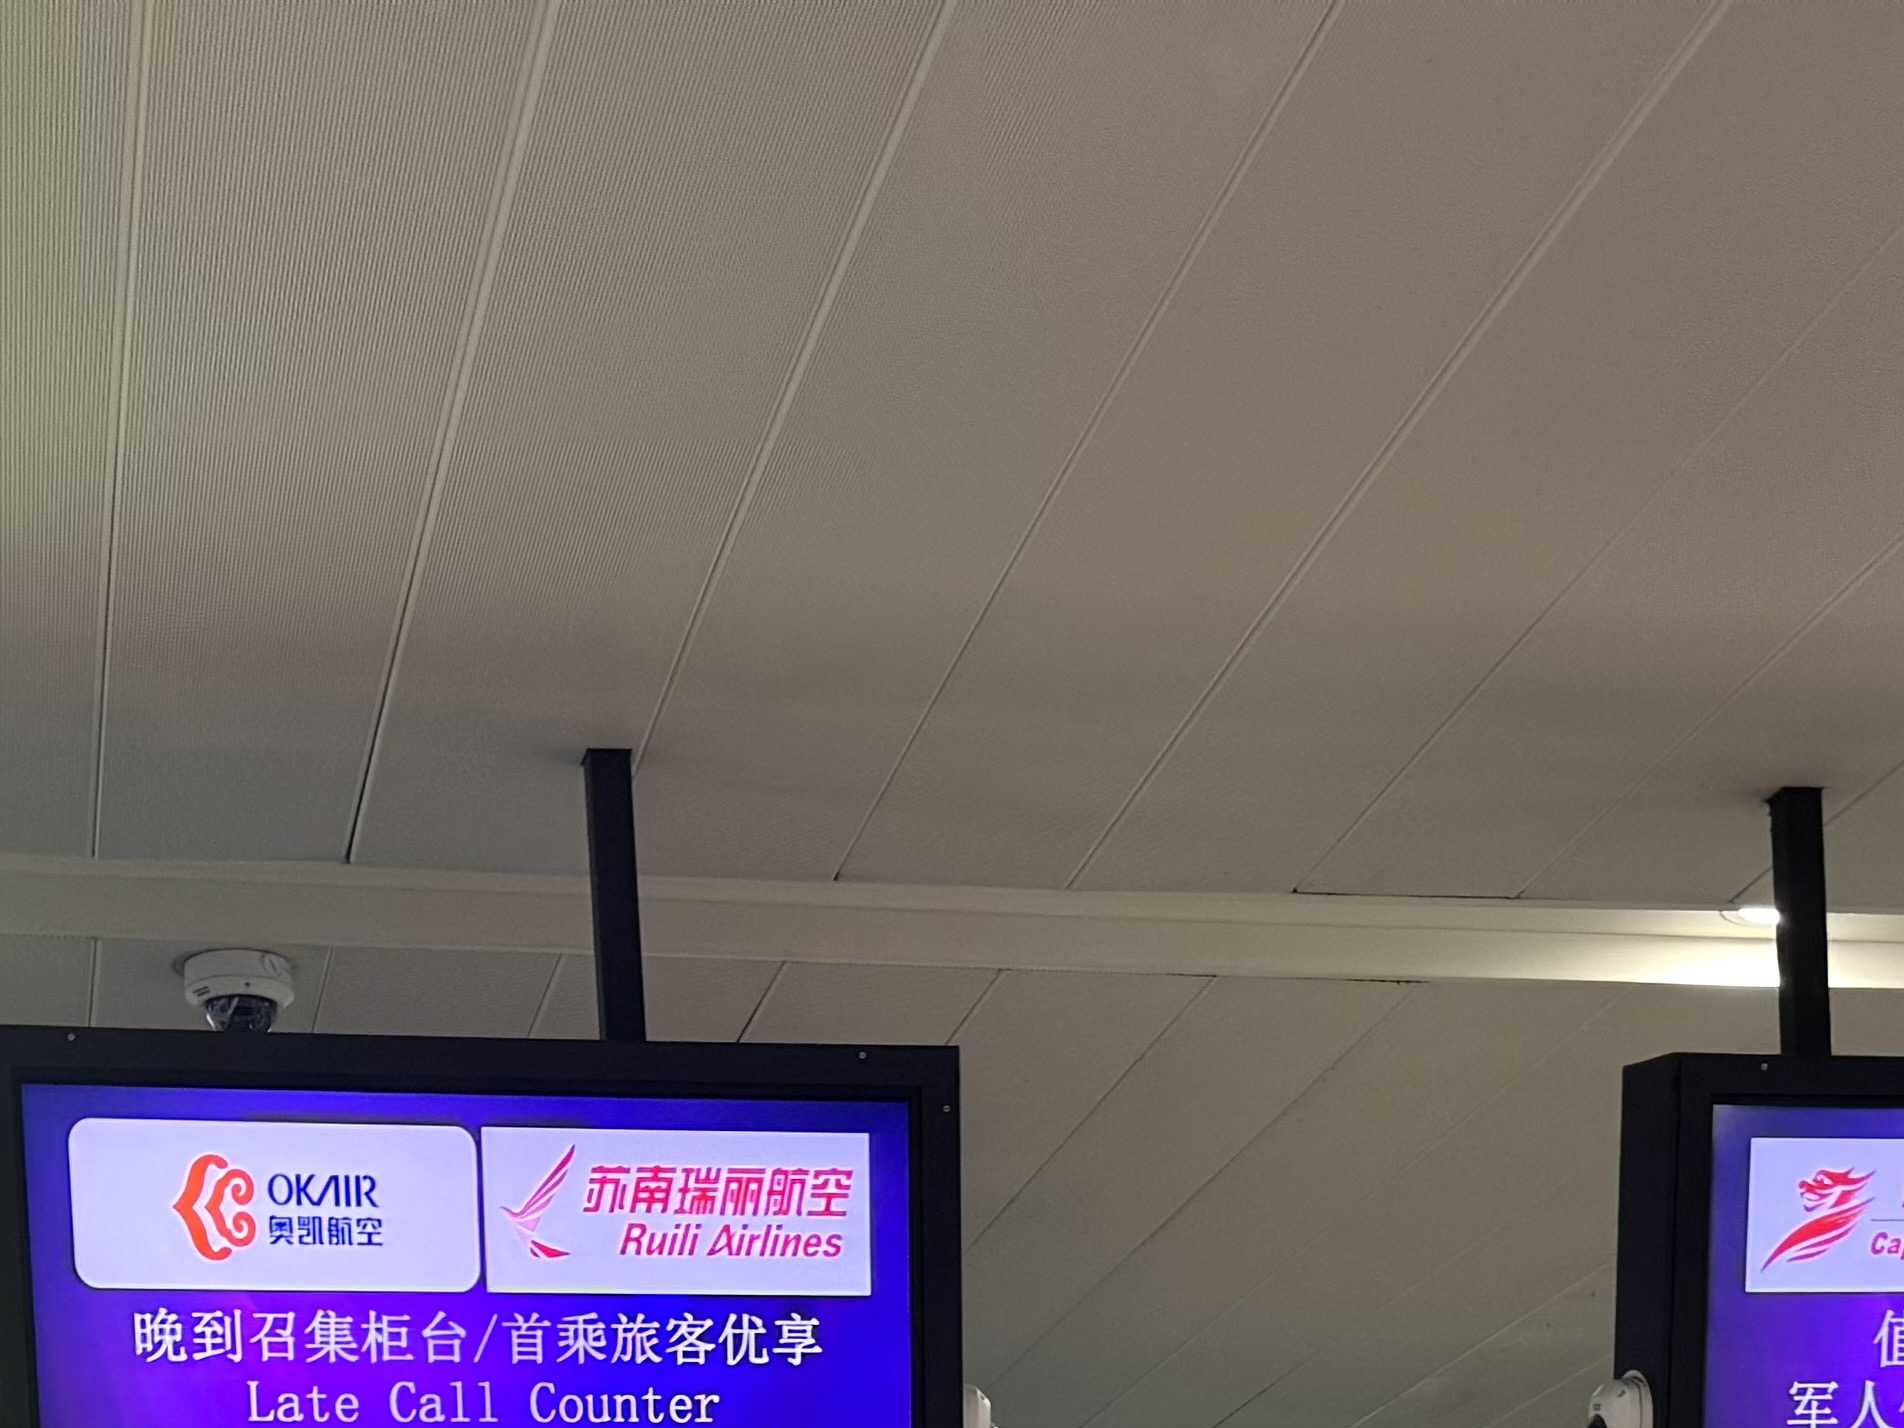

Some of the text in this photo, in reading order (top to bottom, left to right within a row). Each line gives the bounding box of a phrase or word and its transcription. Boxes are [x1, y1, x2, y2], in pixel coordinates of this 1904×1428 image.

[267, 1173, 379, 1208] OKAIR
[583, 1165, 854, 1218] 苏南瑞丽航空
[268, 1215, 384, 1247] 奥凯航空
[619, 1223, 844, 1258] Ruili Airlines
[133, 1307, 824, 1367] 晚到召集柜台/首乘旅客优享
[247, 1380, 721, 1425] Late Call Counter
